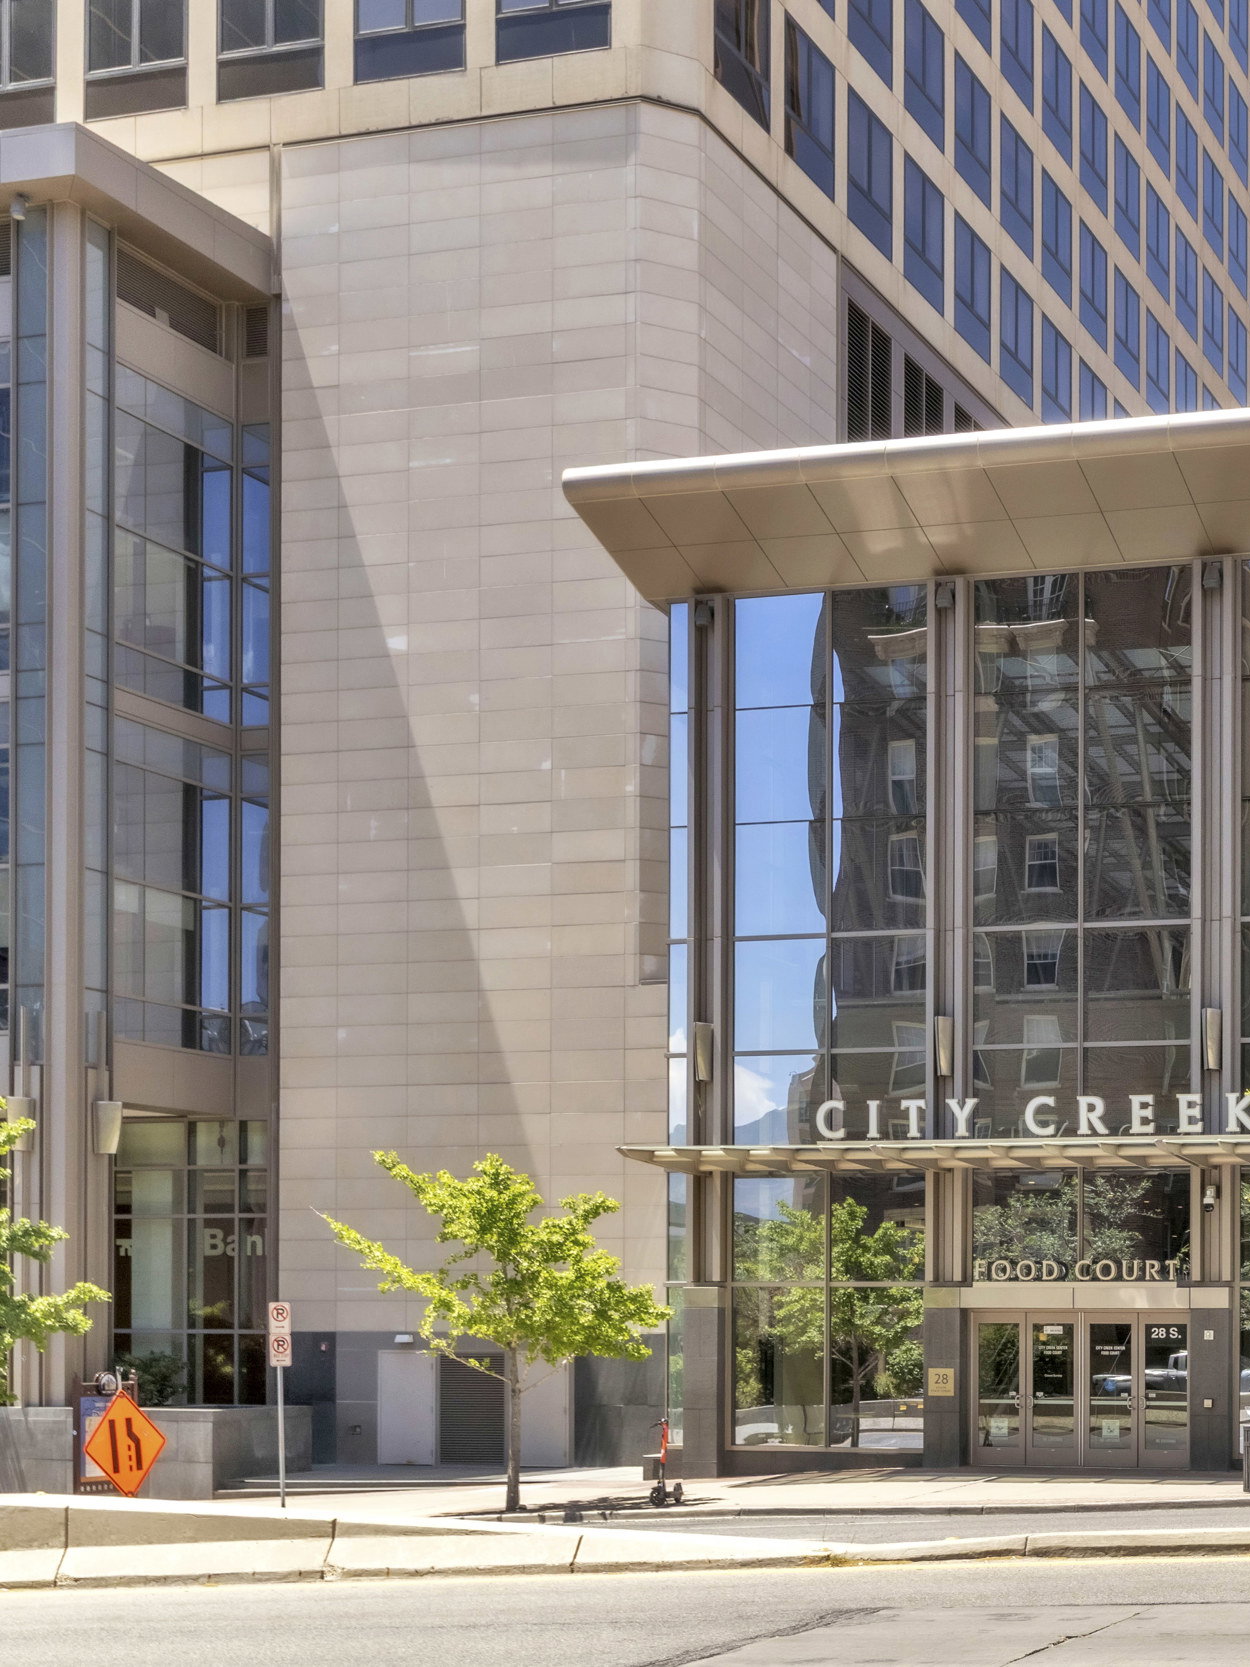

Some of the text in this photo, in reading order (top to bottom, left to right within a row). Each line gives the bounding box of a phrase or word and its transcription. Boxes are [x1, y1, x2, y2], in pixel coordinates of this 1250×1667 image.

[815, 1098, 978, 1140] CITY
[203, 1228, 267, 1257] Ban
[974, 1258, 1178, 1282] FOOD COURT
[1151, 1327, 1182, 1339] 28 S.
[934, 1373, 949, 1385] 28
